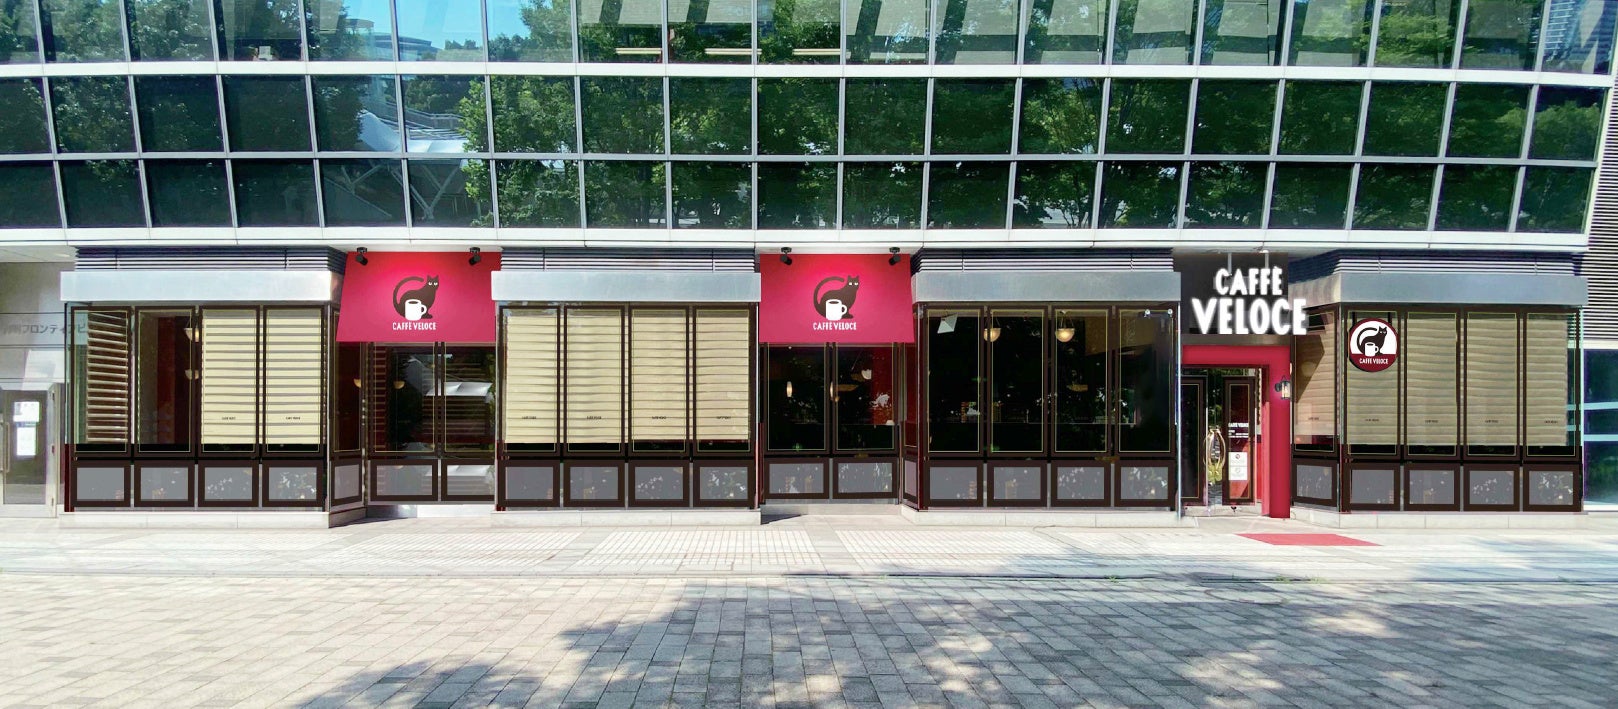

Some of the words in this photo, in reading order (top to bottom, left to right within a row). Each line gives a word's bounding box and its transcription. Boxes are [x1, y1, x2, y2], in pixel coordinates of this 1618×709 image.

[1215, 265, 1283, 295] CAFFÈ
[413, 322, 437, 330] VELOCE
[833, 322, 857, 330] VELOCE
[1191, 298, 1307, 335] VELOCE
